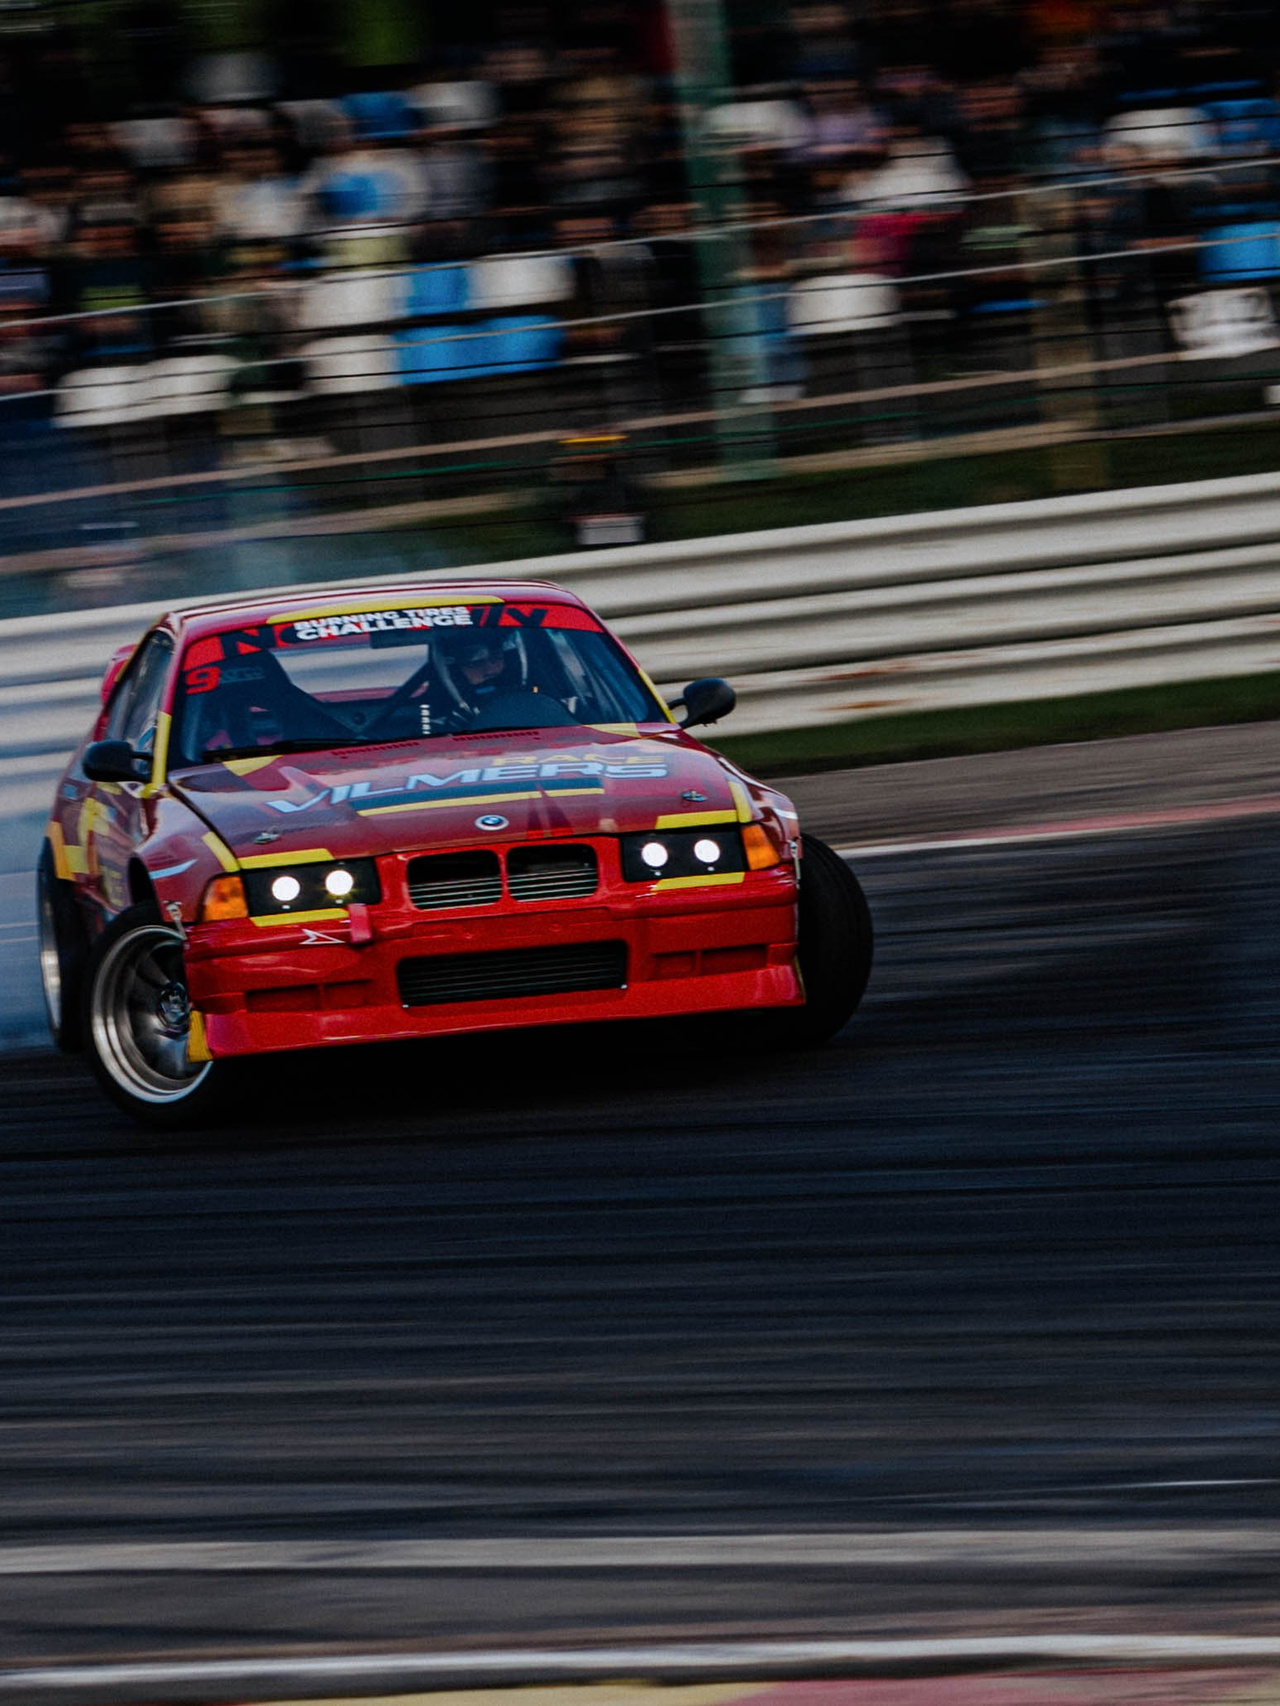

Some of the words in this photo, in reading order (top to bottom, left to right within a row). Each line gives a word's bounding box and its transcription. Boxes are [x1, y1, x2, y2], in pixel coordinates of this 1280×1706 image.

[293, 610, 400, 631] BURNING
[405, 606, 470, 619] TIRES
[296, 614, 473, 641] CHALLENGE
[184, 665, 221, 695] 9
[491, 753, 665, 766] RACE
[265, 761, 669, 814] VILMERS
